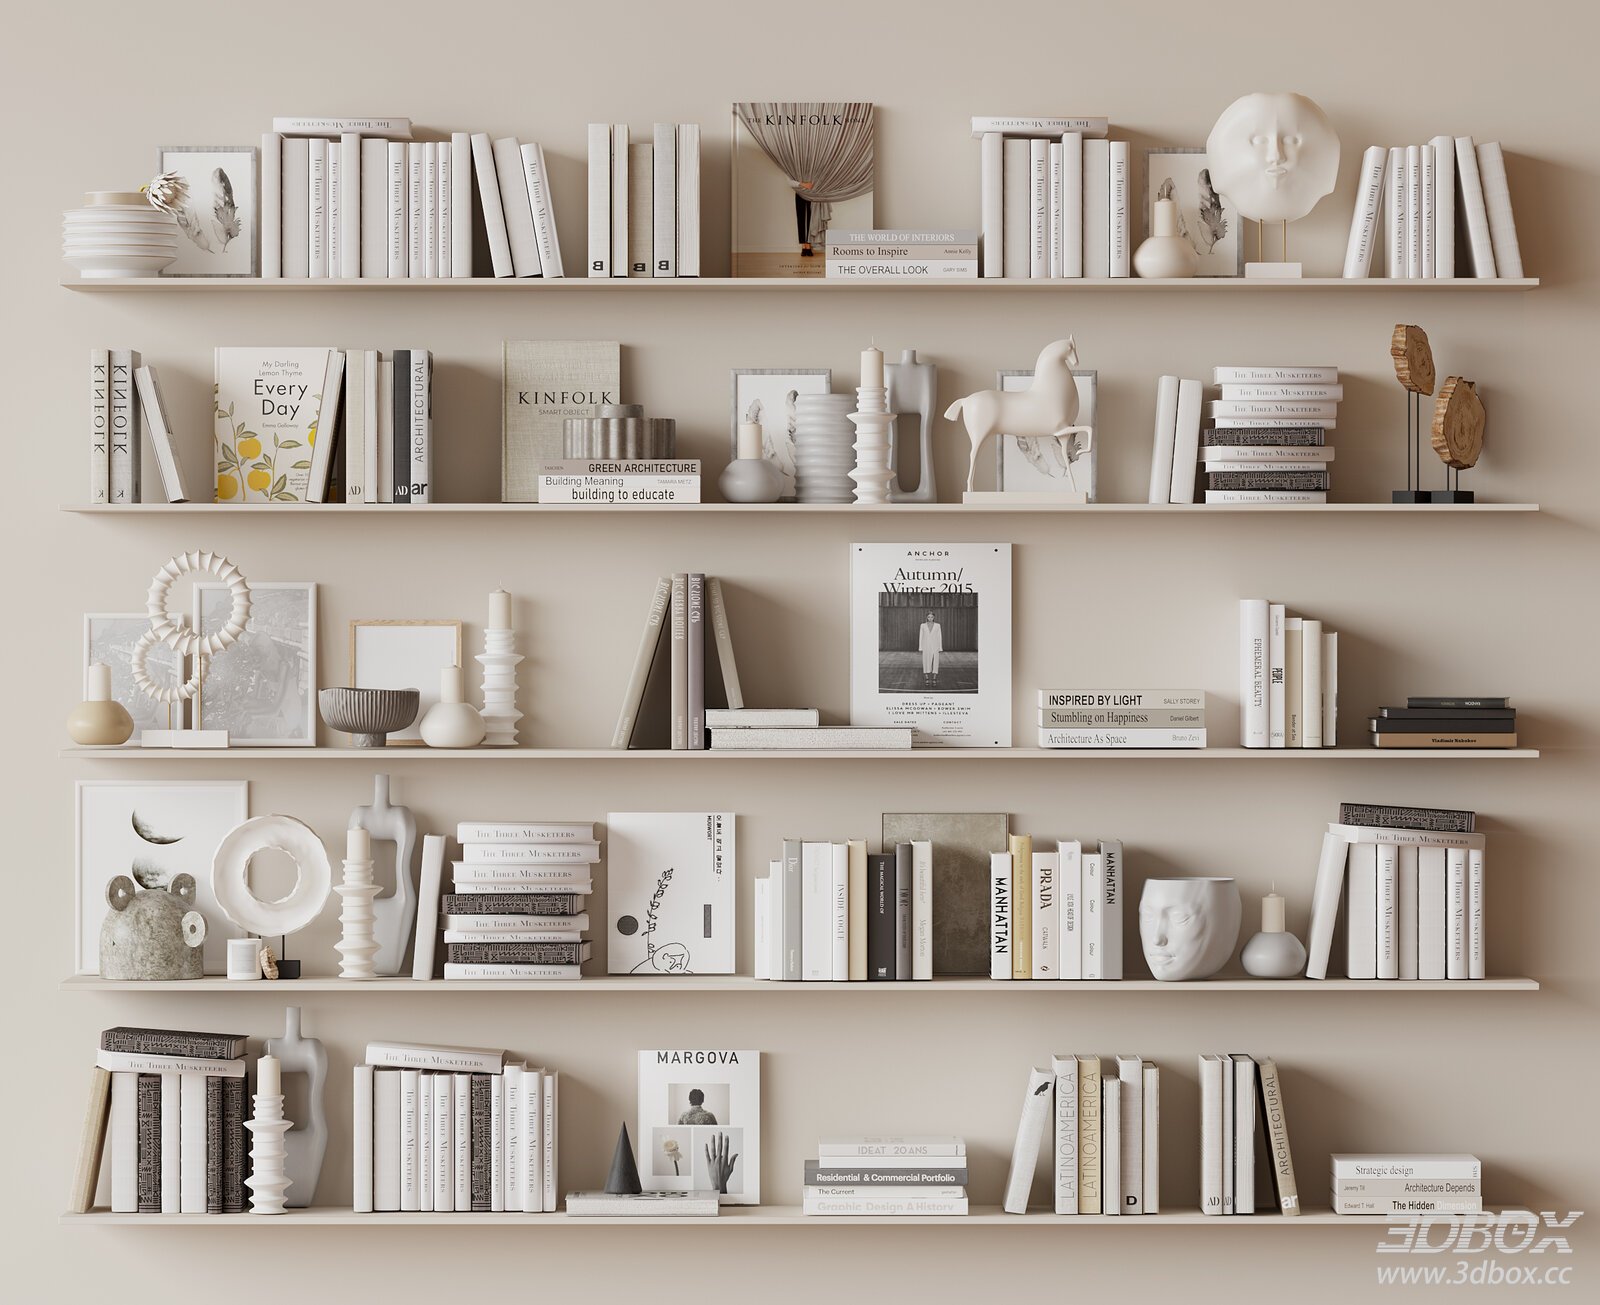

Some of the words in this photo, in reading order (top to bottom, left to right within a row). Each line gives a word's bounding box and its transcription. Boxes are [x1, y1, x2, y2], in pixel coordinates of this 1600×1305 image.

[766, 115, 843, 126] KINFOLK
[850, 234, 865, 242] THE
[867, 234, 897, 242] WORLD
[900, 234, 909, 242] OF
[912, 234, 954, 242] INTERIORS
[833, 247, 863, 256] Rooms
[878, 247, 908, 258] Inspire
[838, 266, 855, 274] THE
[858, 266, 900, 274] OVERALL
[903, 266, 928, 274] LOOK
[262, 361, 272, 370] My
[275, 361, 299, 370] Darling
[282, 370, 302, 378] Thyme
[254, 379, 308, 400] Every
[519, 391, 613, 404] KINFOLK
[262, 399, 300, 421] Day
[415, 360, 424, 462] ARCHITECTURAL
[589, 464, 621, 473] GREEN
[625, 464, 696, 473] ARCHITECTURE
[546, 477, 582, 487] Building
[585, 477, 624, 487] Meaning
[348, 486, 361, 495] AD
[395, 486, 407, 495] AD
[412, 483, 428, 495] ar
[572, 488, 614, 502] building
[618, 490, 628, 500] to
[633, 488, 674, 500] educate
[894, 568, 963, 582] Autumn/
[883, 583, 935, 594] Winter
[940, 583, 973, 594] 2015
[1272, 668, 1282, 684] PEOPLE
[1049, 695, 1094, 706] INSPIRED
[1098, 695, 1110, 706] BY
[1114, 695, 1142, 706] LIGHT
[1052, 712, 1092, 725] Stumbling
[1107, 712, 1148, 725] Happiness
[1048, 734, 1092, 744] Architecture
[1094, 734, 1103, 744] As
[1106, 734, 1127, 746] Space
[1106, 853, 1115, 904] MANHATTAN
[1040, 869, 1052, 909] PRADA
[995, 878, 1007, 953] MANHATTAN
[657, 1051, 739, 1064] MARGOVA
[1267, 1073, 1290, 1175] ARCHITECTURAL
[1060, 1073, 1074, 1198] LATINOAMERICA
[1083, 1072, 1097, 1198] LATINOAMERICA
[858, 1146, 885, 1155] IDEAT
[894, 1146, 907, 1155] 20
[908, 1146, 927, 1155] ANS
[1356, 1165, 1387, 1177] Strategic
[1390, 1165, 1414, 1177] design
[817, 1174, 860, 1182] Residential
[864, 1174, 870, 1182] &
[871, 1174, 920, 1182] Commercial
[921, 1174, 955, 1182] Portfolio
[1405, 1183, 1443, 1192] Architecture
[1446, 1183, 1475, 1194] Depends
[1126, 1196, 1137, 1205] D
[1207, 1197, 1220, 1206] AD
[1223, 1196, 1231, 1206] AD
[1281, 1195, 1297, 1209] ar
[1392, 1201, 1406, 1210] The
[1408, 1201, 1435, 1210] Hidden
[1437, 1201, 1476, 1210] Dimension
[818, 1202, 862, 1213] Graphic
[866, 1202, 904, 1213] Design
[907, 1202, 916, 1211] A
[917, 1202, 954, 1213] History
